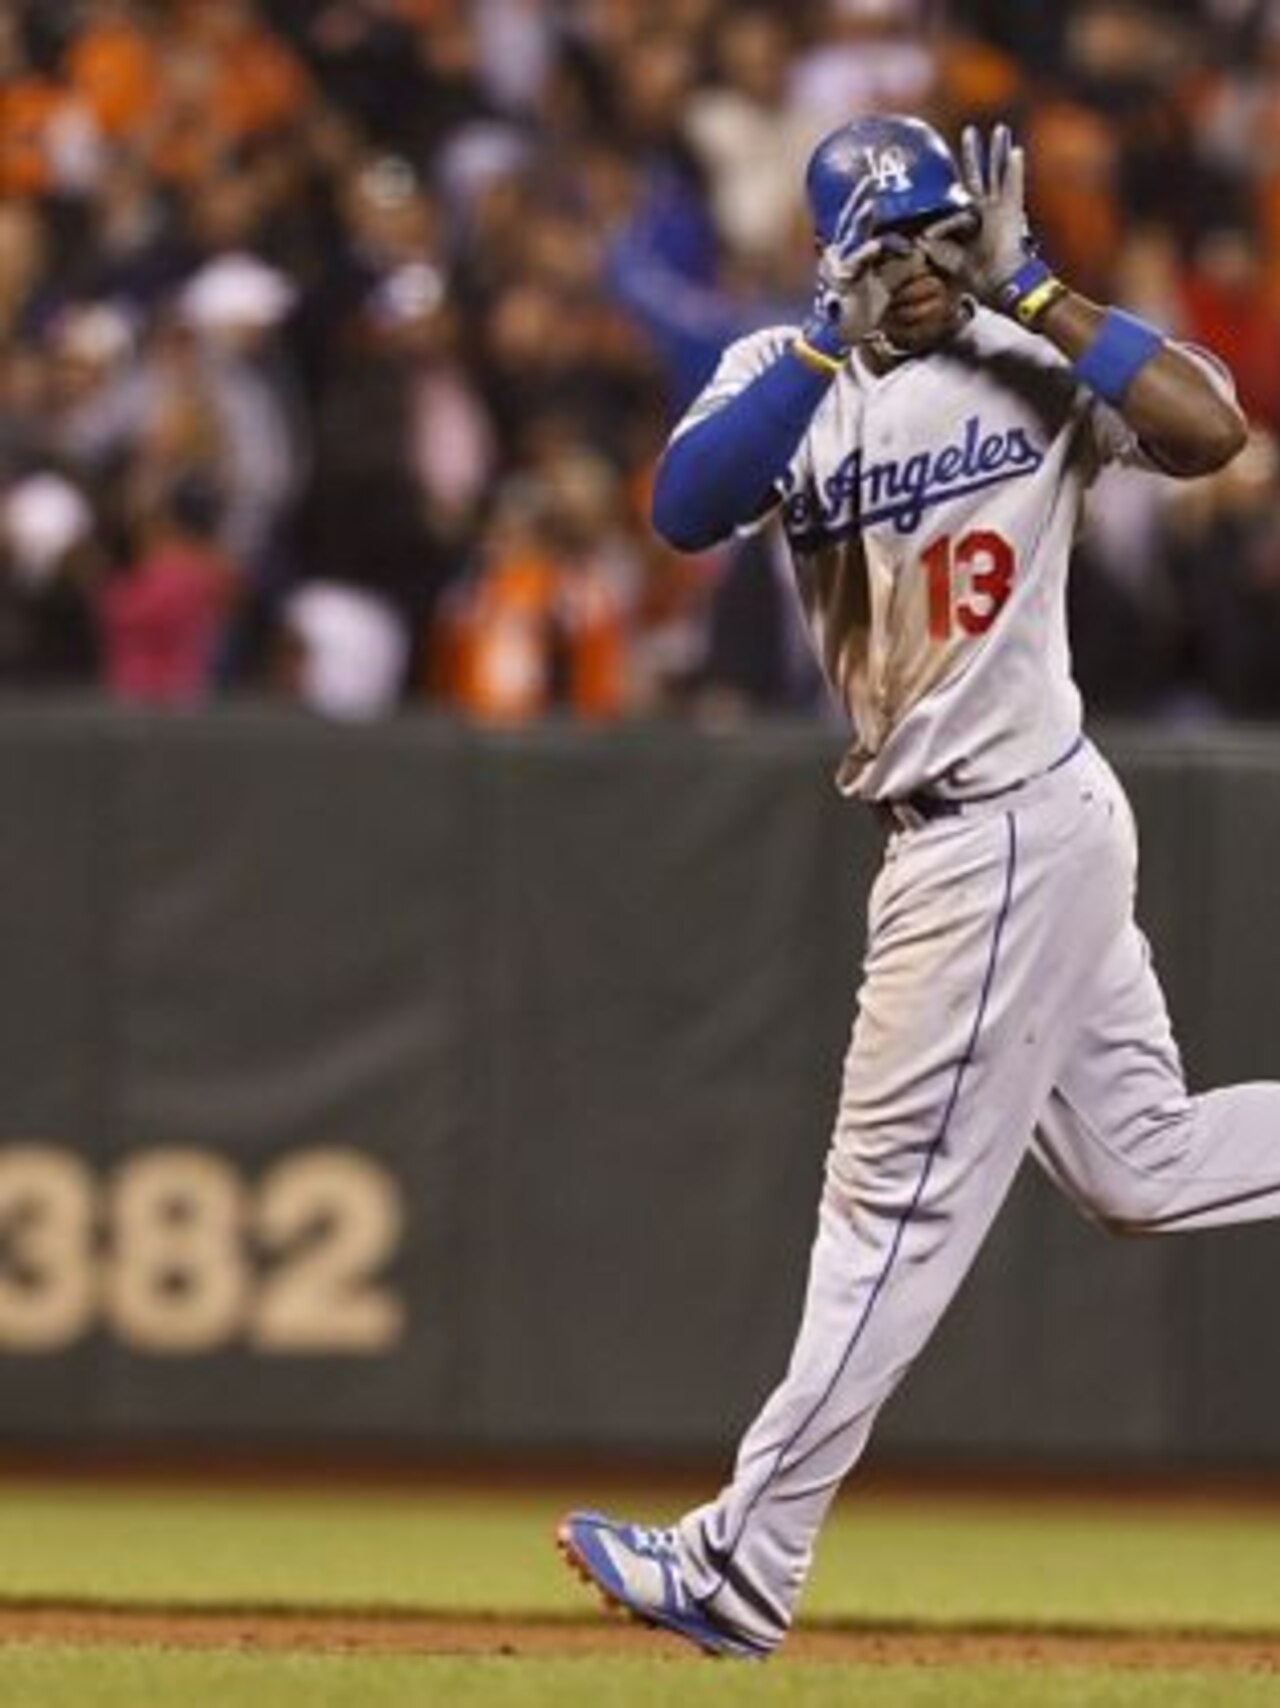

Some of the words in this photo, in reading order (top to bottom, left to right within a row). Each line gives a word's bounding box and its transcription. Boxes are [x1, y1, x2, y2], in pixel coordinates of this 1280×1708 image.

[863, 145, 914, 193] LA
[824, 415, 1044, 535] Angeles
[920, 528, 1016, 640] 13
[0, 1140, 408, 1356] 382
